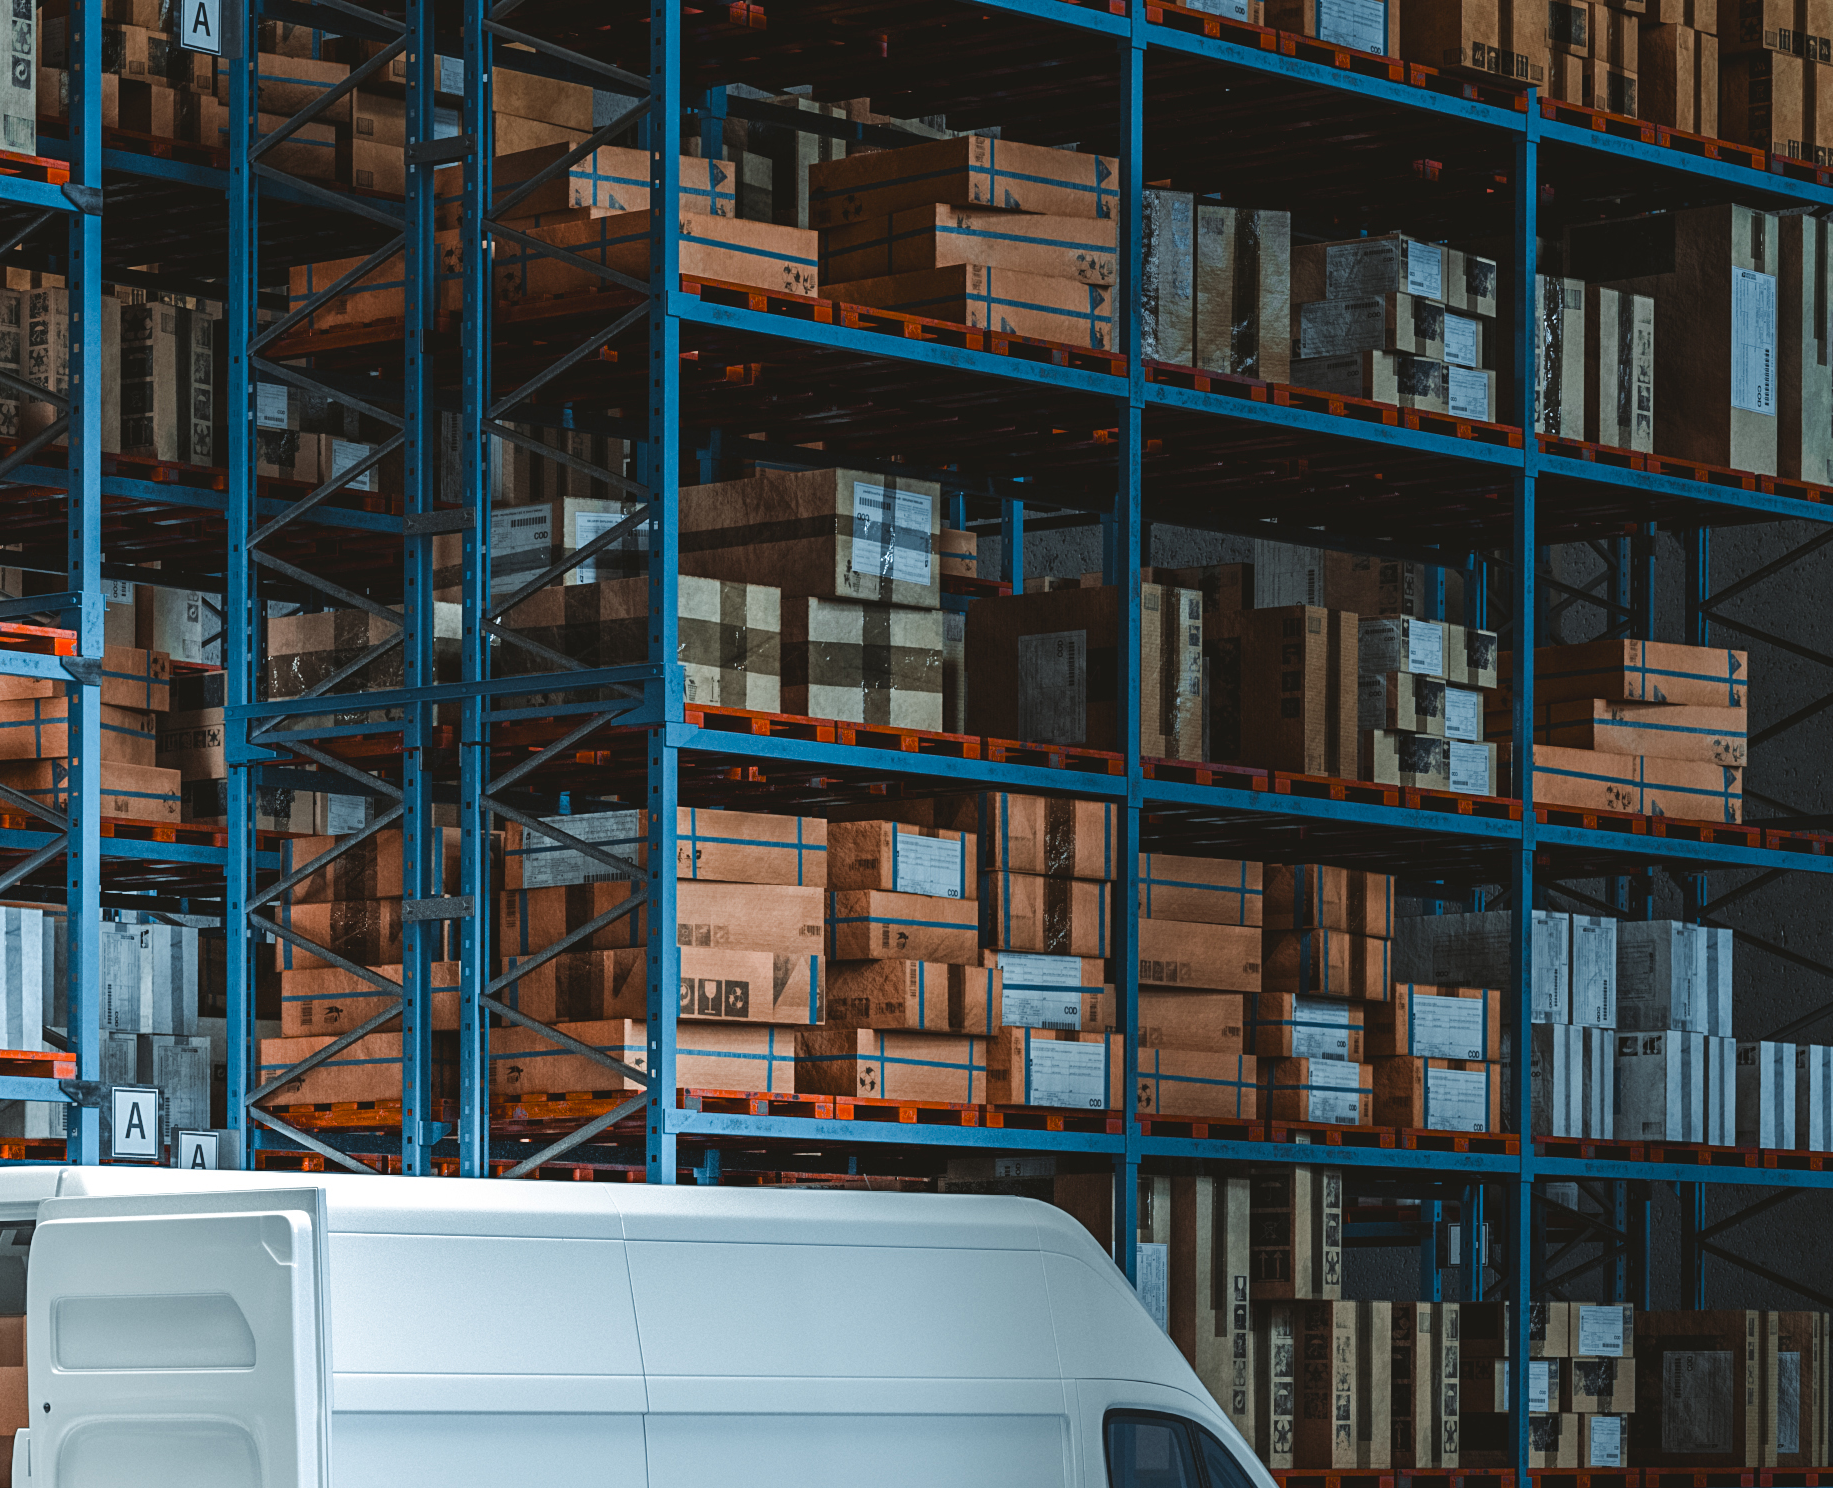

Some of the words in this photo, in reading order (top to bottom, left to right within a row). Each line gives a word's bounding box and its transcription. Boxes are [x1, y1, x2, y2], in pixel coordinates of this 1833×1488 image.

[191, 1, 211, 37] A
[534, 532, 548, 540] COD
[1064, 1006, 1078, 1015] COD
[1089, 1099, 1102, 1107] COD
[125, 1103, 146, 1140] A
[191, 1144, 207, 1168] A
